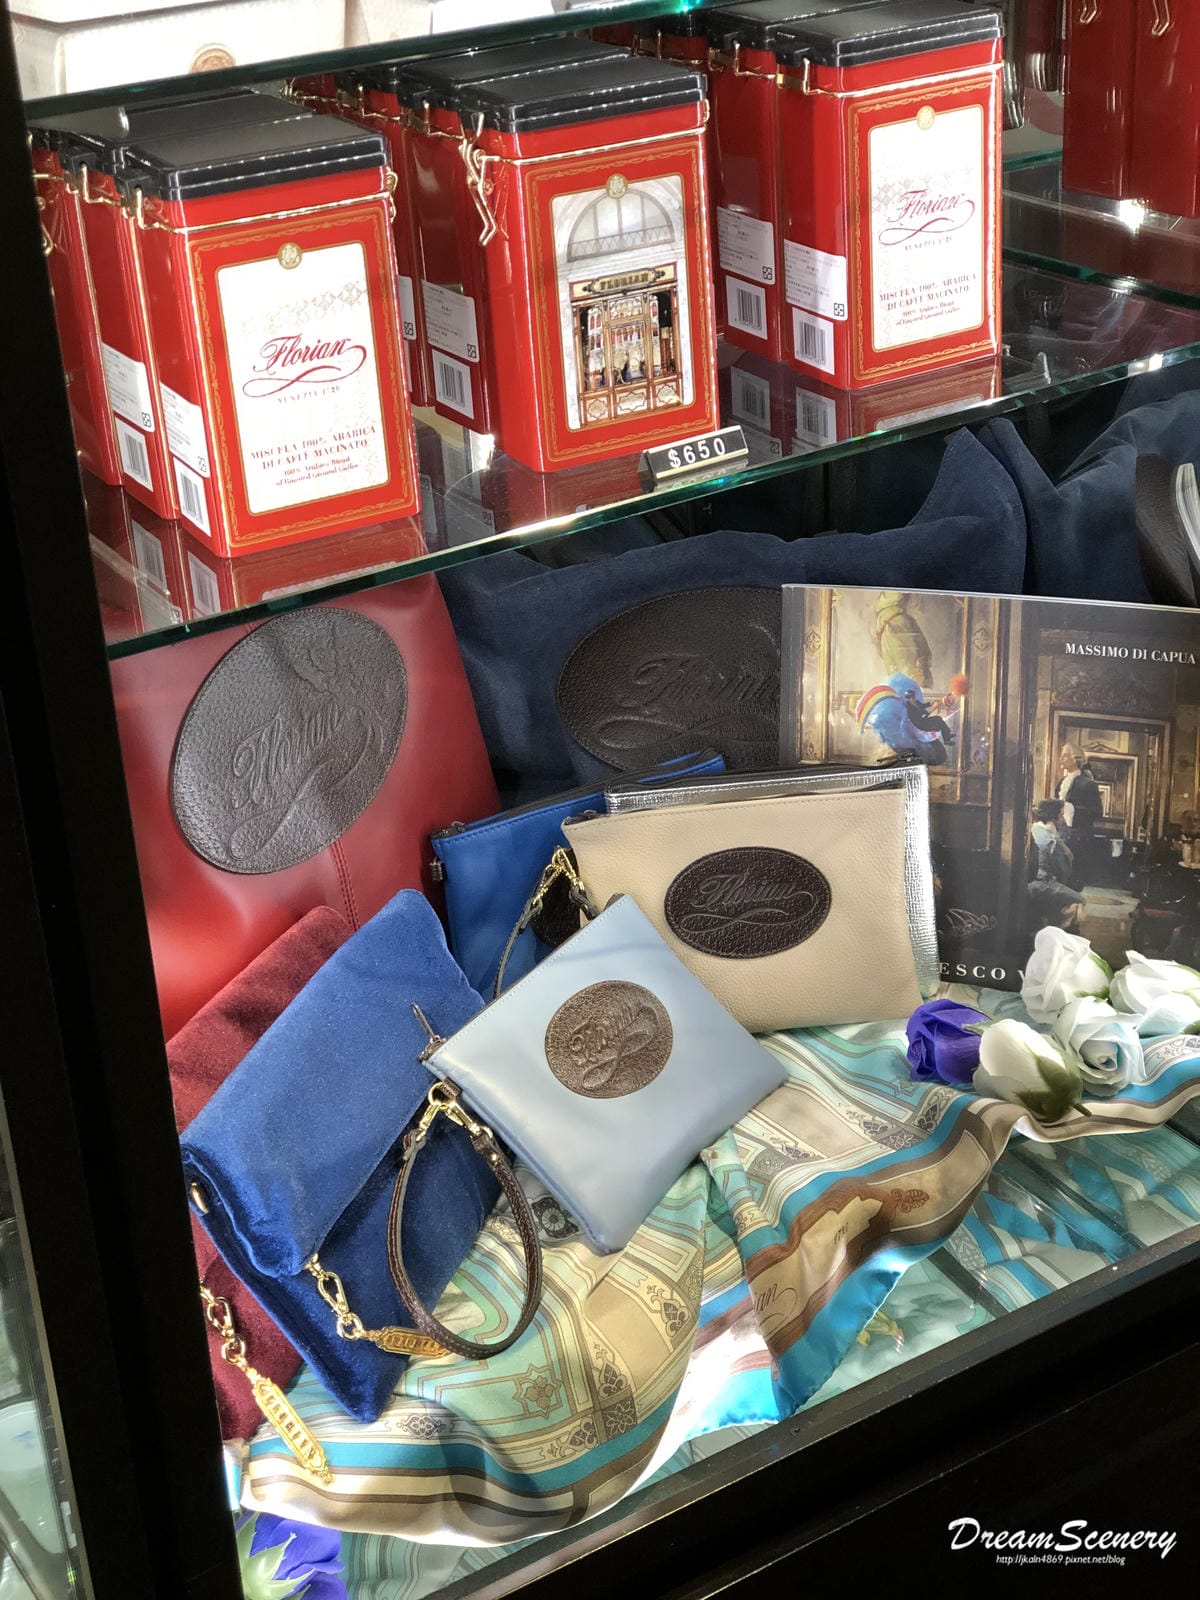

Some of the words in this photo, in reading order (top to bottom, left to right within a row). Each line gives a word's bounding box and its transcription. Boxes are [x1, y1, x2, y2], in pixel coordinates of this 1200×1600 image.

[244, 333, 365, 391] Florian
[668, 437, 726, 468] $650
[1065, 642, 1129, 659] MASSIMO
[1132, 648, 1148, 660] DI
[1151, 650, 1196, 665] CAPUA
[940, 962, 1006, 980] ESCO
